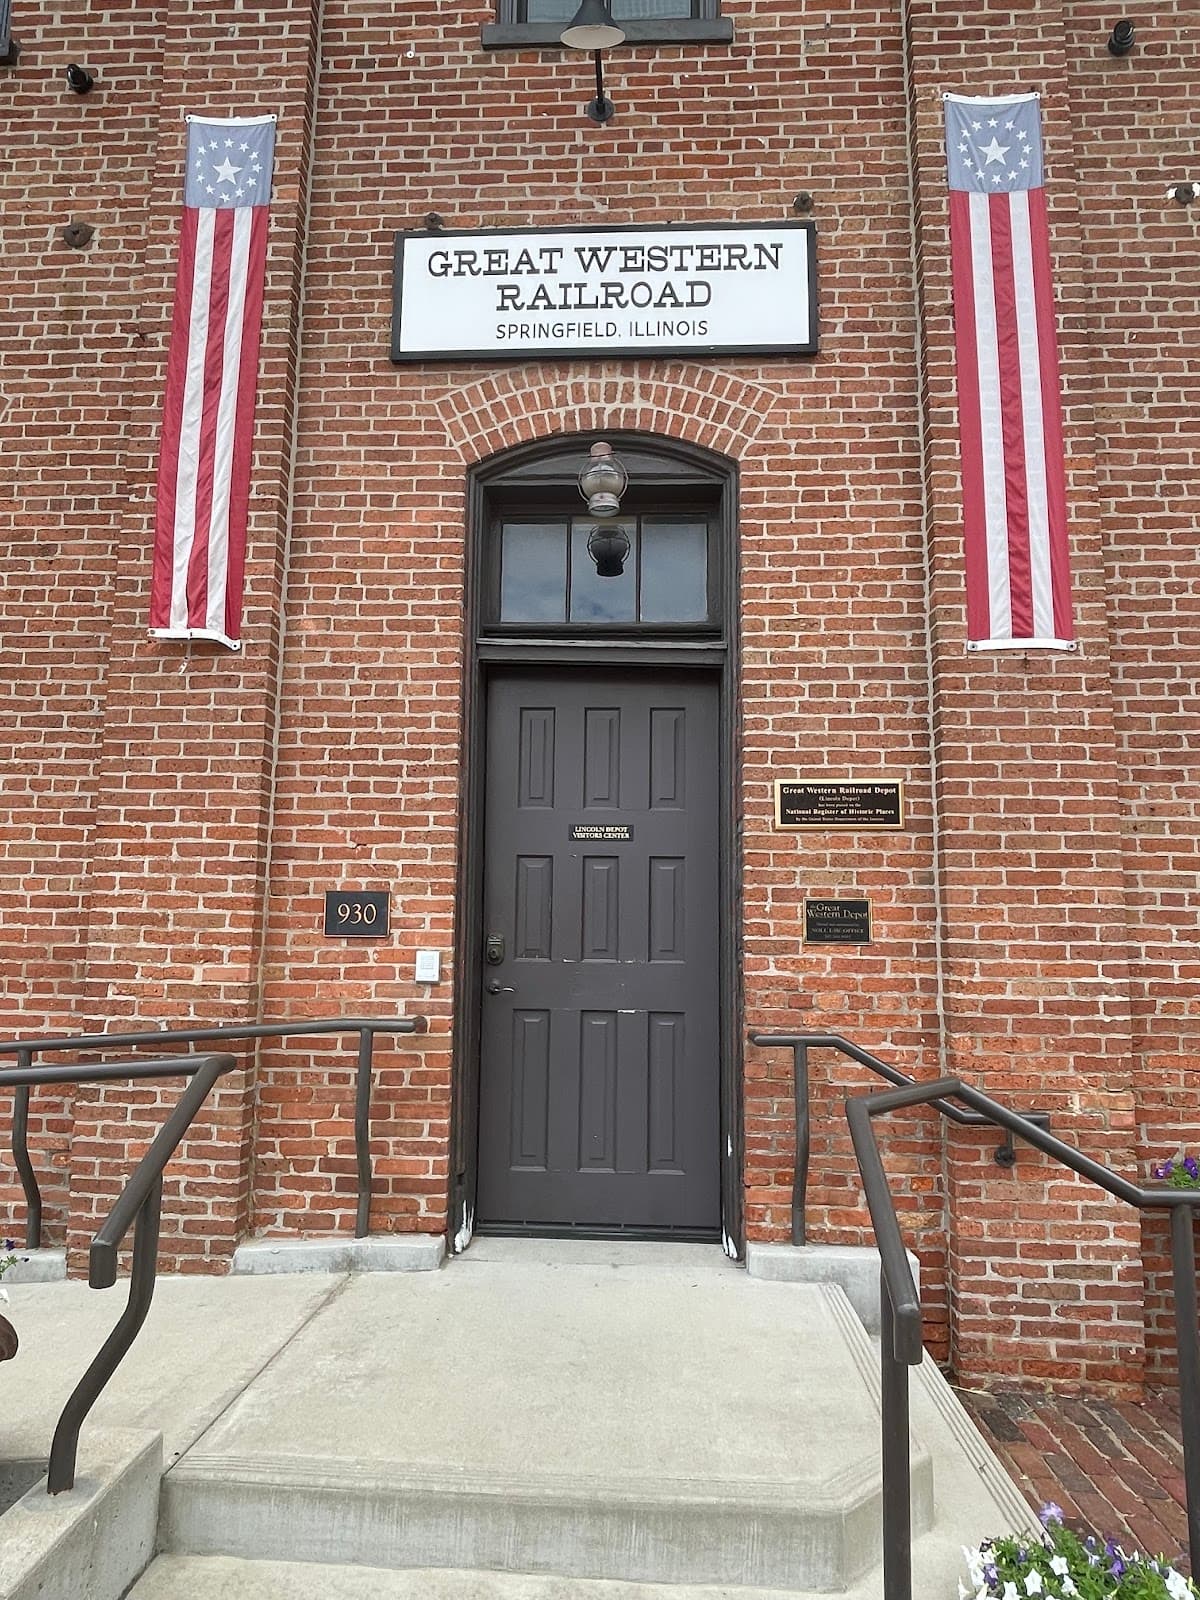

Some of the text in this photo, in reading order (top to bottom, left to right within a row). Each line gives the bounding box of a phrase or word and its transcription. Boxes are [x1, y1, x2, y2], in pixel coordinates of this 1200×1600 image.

[428, 243, 783, 277] GREAT WESTERN
[496, 280, 712, 311] RAILROAD
[629, 320, 708, 337] ILLINOIS
[874, 787, 897, 796] Depot
[813, 808, 839, 816] Register
[337, 903, 377, 925] 930
[816, 903, 840, 911] Great
[807, 909, 868, 920] Western Depot
